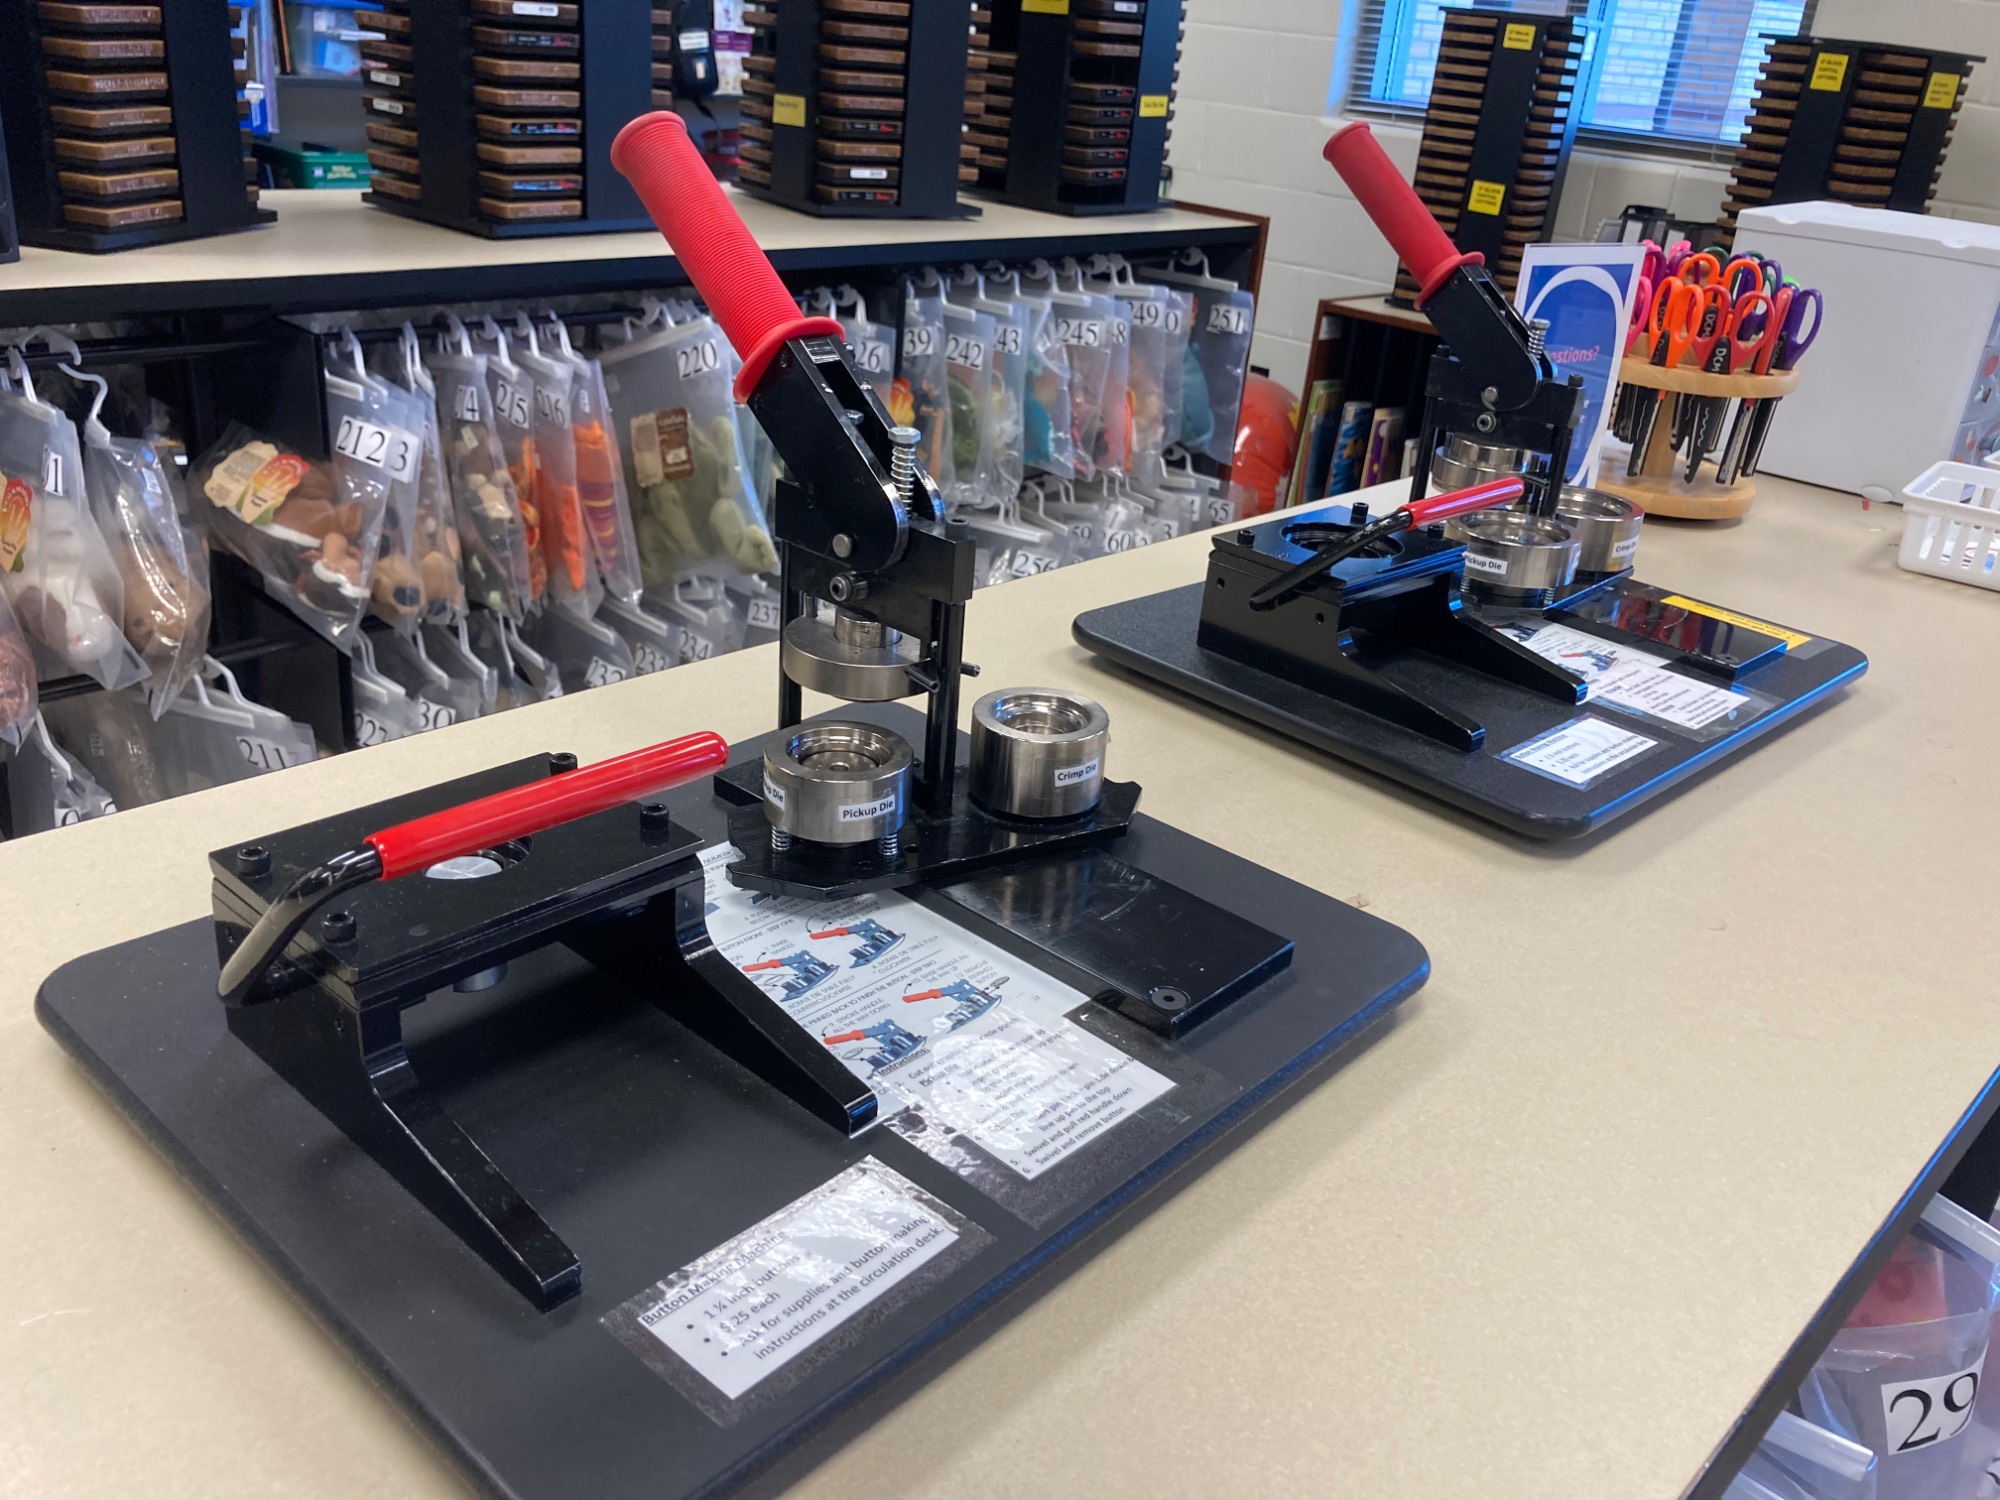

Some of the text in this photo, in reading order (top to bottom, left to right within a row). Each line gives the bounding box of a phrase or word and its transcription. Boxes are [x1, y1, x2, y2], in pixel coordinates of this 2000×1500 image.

[1058, 319, 1098, 345] 245
[1211, 307, 1243, 334] 251
[904, 329, 932, 355] 39
[947, 337, 982, 368] 242
[993, 327, 1020, 354] 43
[679, 341, 717, 378] 220
[856, 341, 881, 371] 26
[1550, 345, 1600, 364] estions?
[1711, 347, 1727, 372] DCM
[497, 383, 527, 425] 215
[337, 420, 386, 463] 212
[1488, 560, 1502, 570] Die
[752, 602, 779, 622] 237
[1057, 763, 1097, 781] Crimp Die
[772, 788, 784, 802] Die
[842, 799, 894, 819] Pickup Die
[831, 1004, 848, 1014] BACK
[908, 1069, 923, 1078] Cut
[1024, 1140, 1050, 1156] Swivel
[1048, 1131, 1063, 1141] and
[1062, 1121, 1079, 1133] pull
[1077, 1114, 1090, 1122] red
[1089, 1099, 1114, 1115] handle
[1112, 1087, 1133, 1100] down
[1040, 1121, 1055, 1131] line
[1055, 1115, 1066, 1123] up
[1085, 1093, 1098, 1102] the
[1097, 1086, 1111, 1096] top
[1037, 1148, 1062, 1165] Swivel
[1060, 1139, 1076, 1149] and
[1075, 1121, 1102, 1140] remove
[1101, 1106, 1126, 1123] button
[642, 1231, 786, 1325] Button Making Machine
[727, 1285, 754, 1305] inch
[753, 1254, 800, 1286] buttons
[738, 1214, 928, 1347] Ask for supplies and button making
[749, 1292, 780, 1314] each
[754, 1225, 944, 1360] instructions at the circulation desk.
